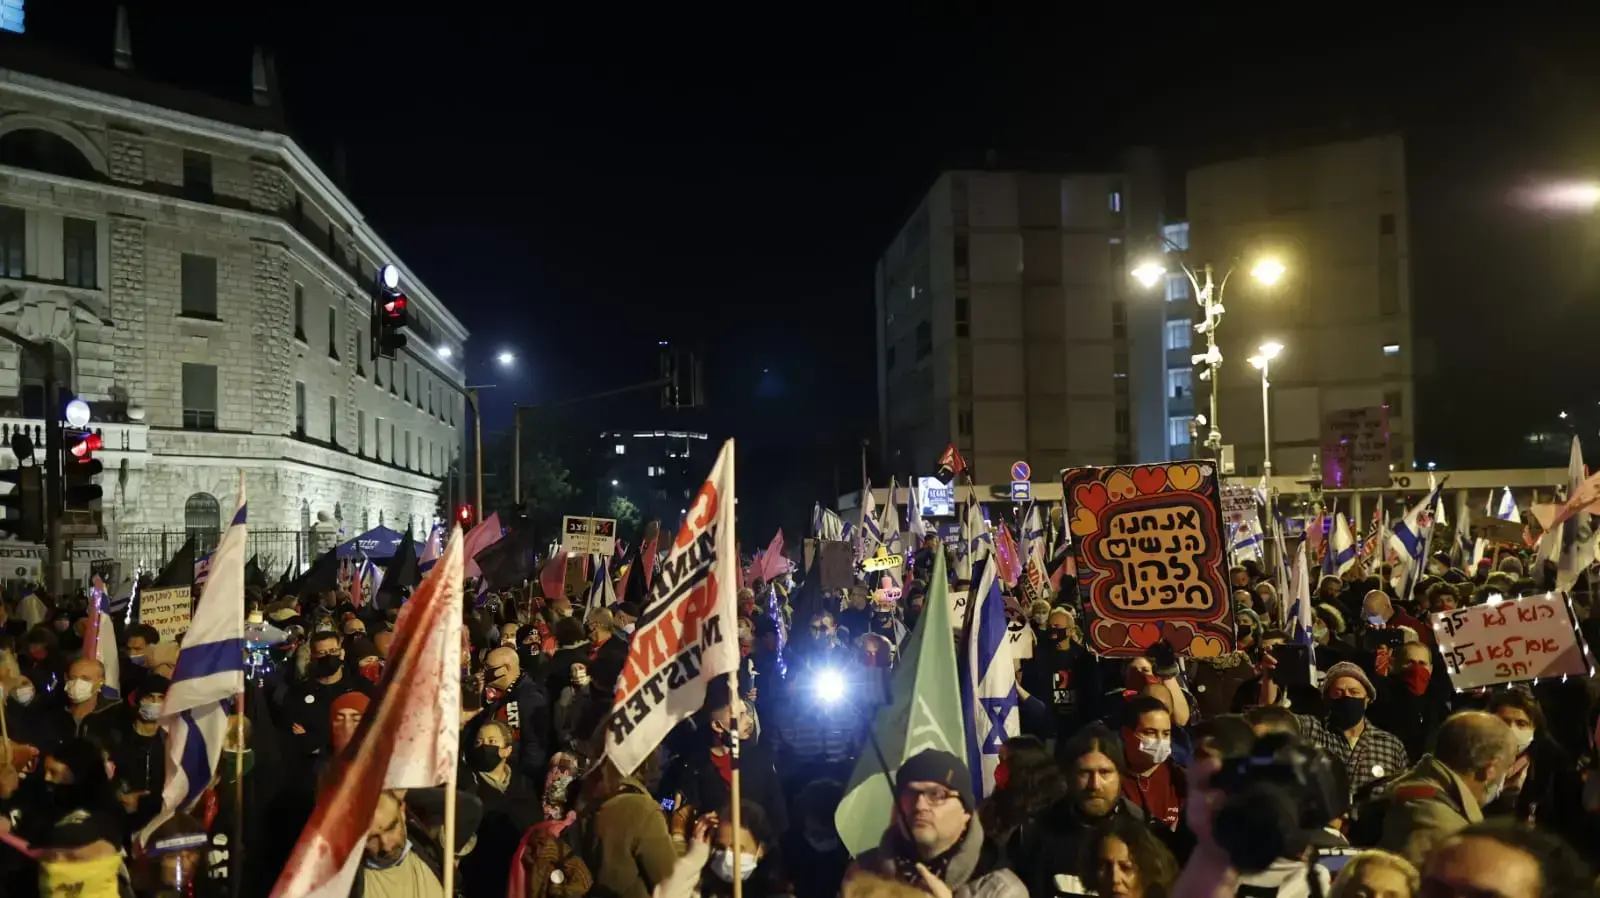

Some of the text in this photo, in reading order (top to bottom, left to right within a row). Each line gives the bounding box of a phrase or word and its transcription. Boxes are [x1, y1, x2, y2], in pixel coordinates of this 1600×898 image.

[1118, 510, 1197, 534] אנחנו
[1107, 535, 1200, 558] הנשים
[1127, 556, 1191, 590] להן
[1122, 583, 1209, 606] חיכינו
[1441, 602, 1555, 637] הוא לא ילך
[1444, 636, 1560, 674] אם לא נלך
